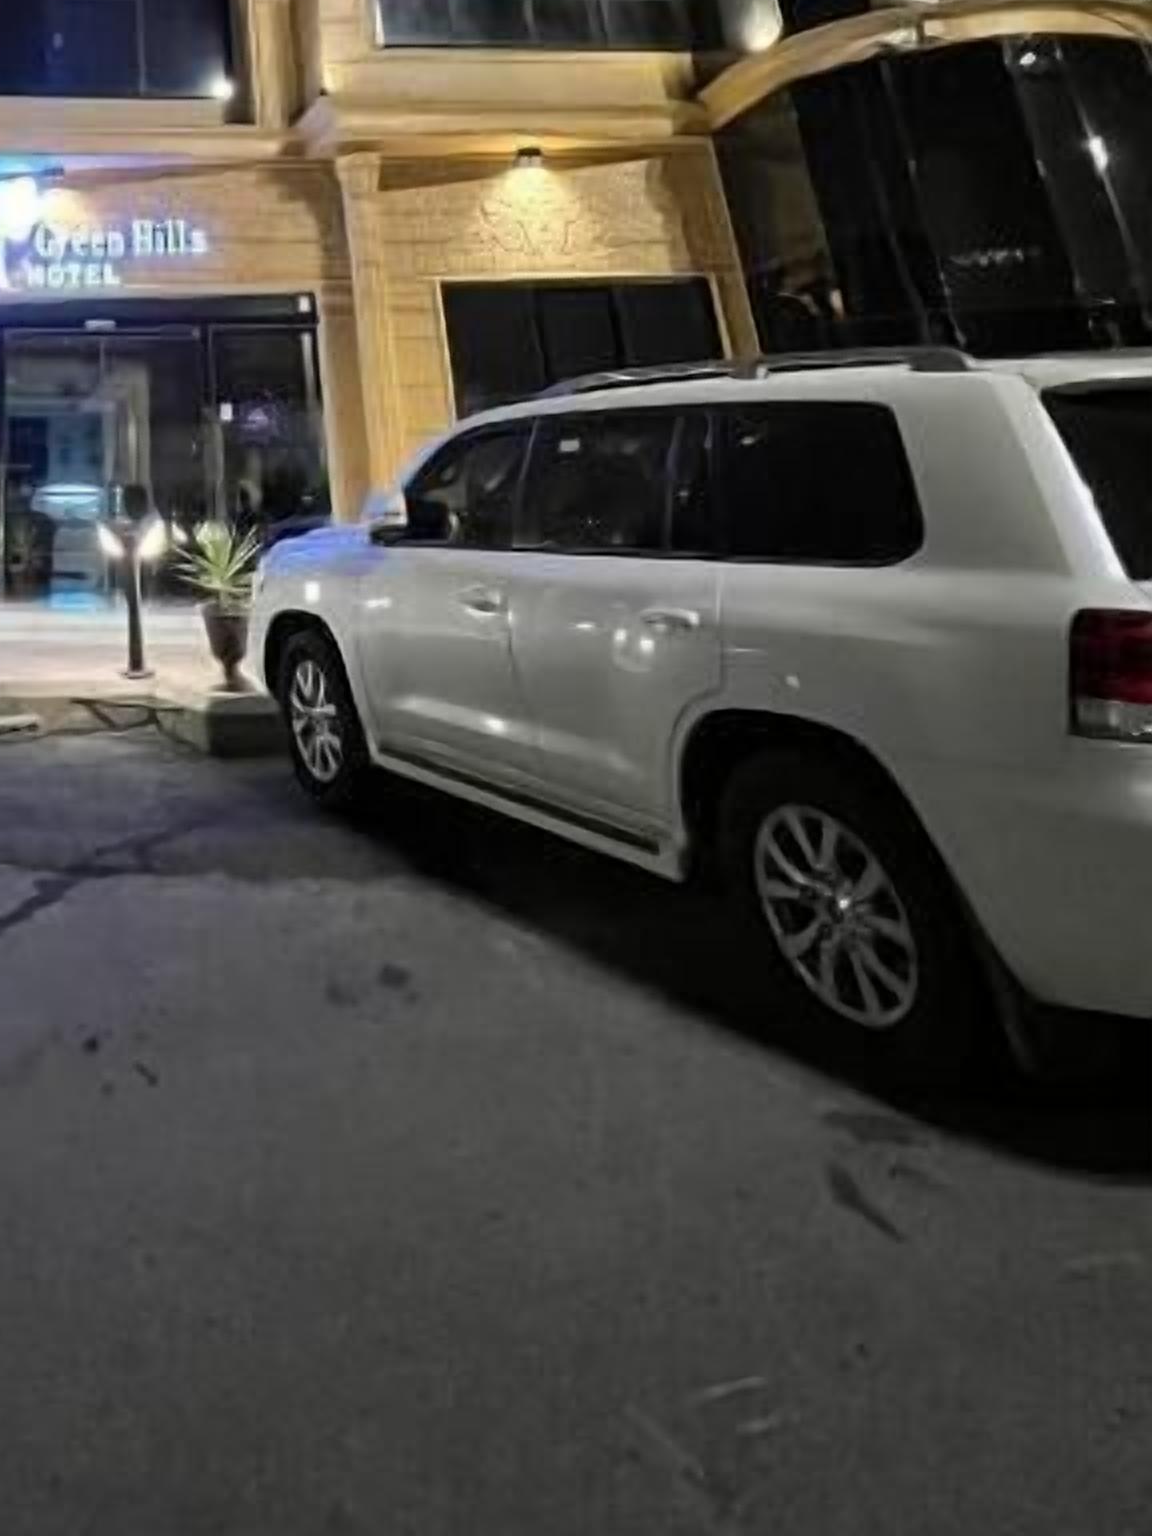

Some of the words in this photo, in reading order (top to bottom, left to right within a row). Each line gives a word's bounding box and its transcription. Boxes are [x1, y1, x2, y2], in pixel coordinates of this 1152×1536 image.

[34, 221, 125, 259] Green
[131, 217, 208, 255] Hills
[25, 263, 121, 287] HOTEL
